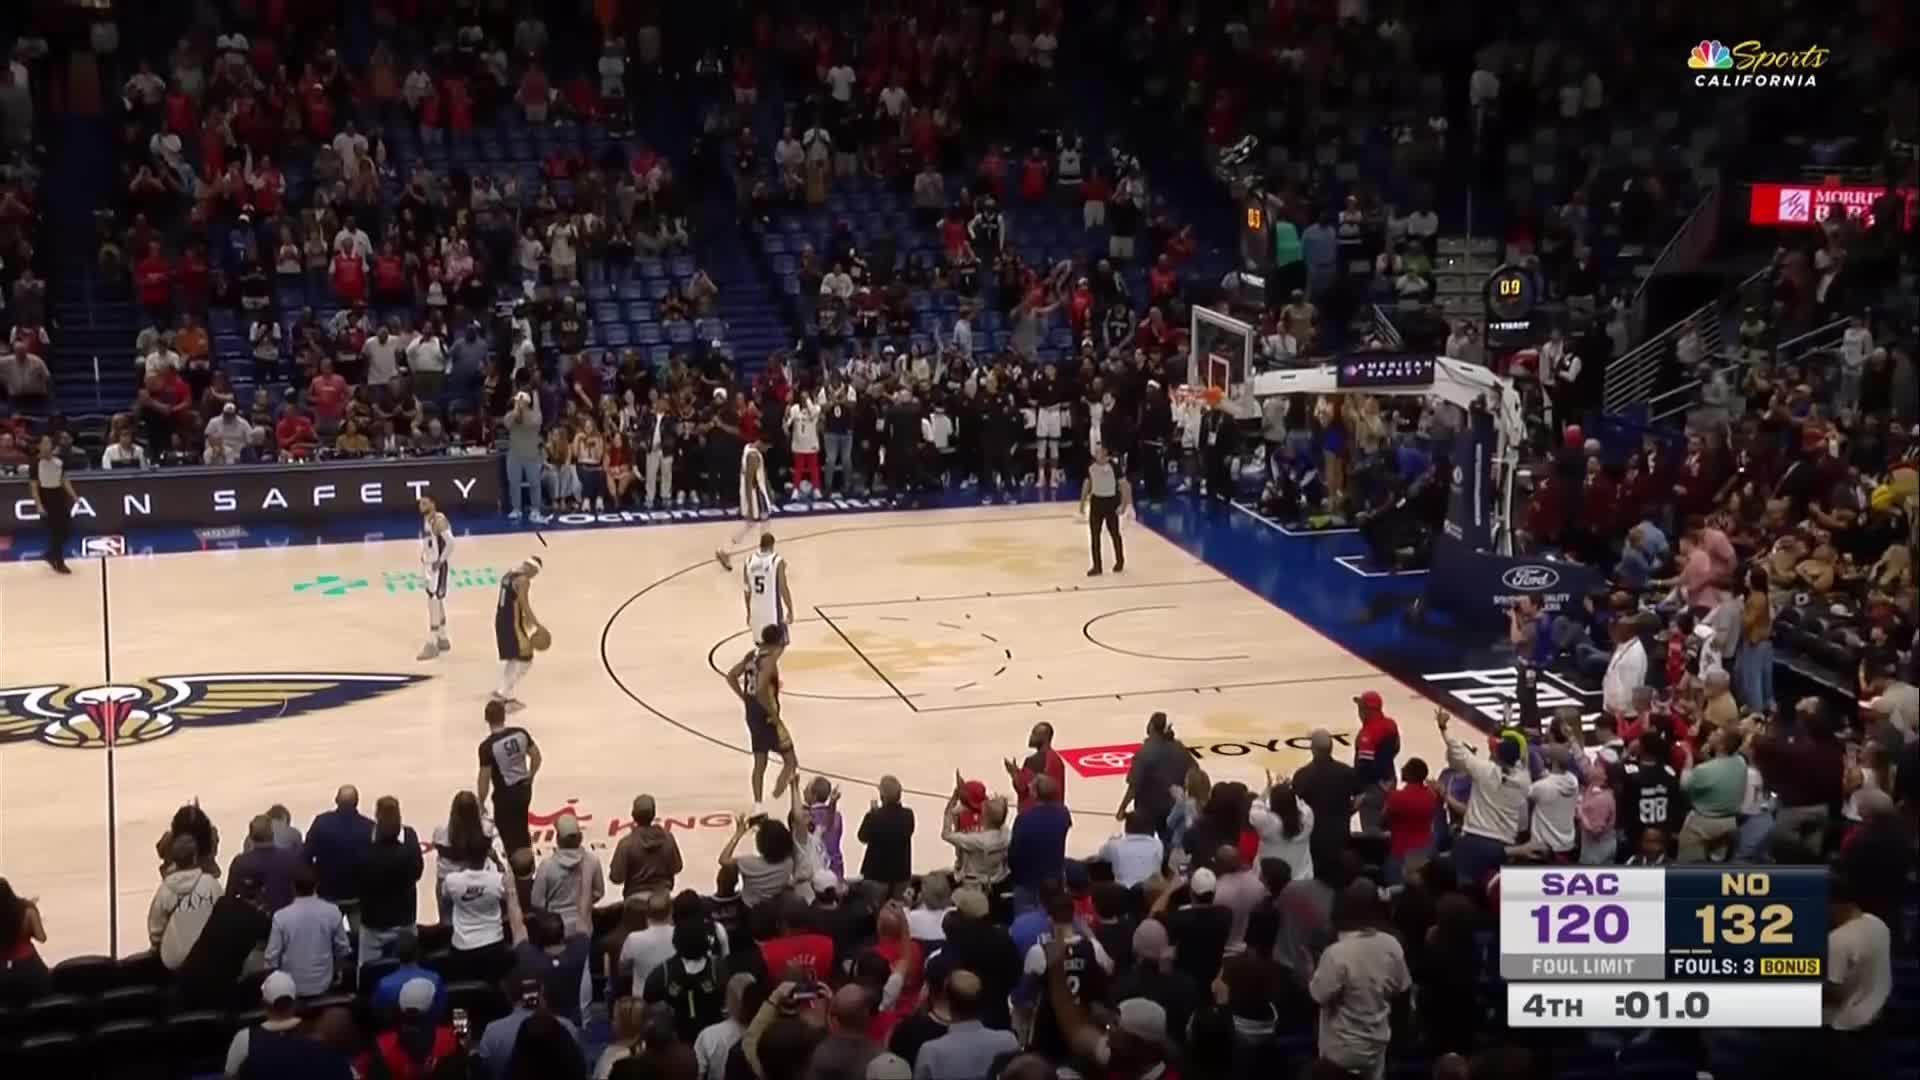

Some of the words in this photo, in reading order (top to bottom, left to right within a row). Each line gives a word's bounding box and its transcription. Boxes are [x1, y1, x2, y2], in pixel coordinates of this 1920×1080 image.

[1358, 360, 1432, 371] AMERICAN
[1367, 368, 1423, 377] SAFETY
[213, 478, 476, 511] SAFETY
[754, 575, 765, 594] 5
[1512, 568, 1549, 587] Ford
[503, 737, 520, 757] 50
[607, 812, 733, 838] KNG
